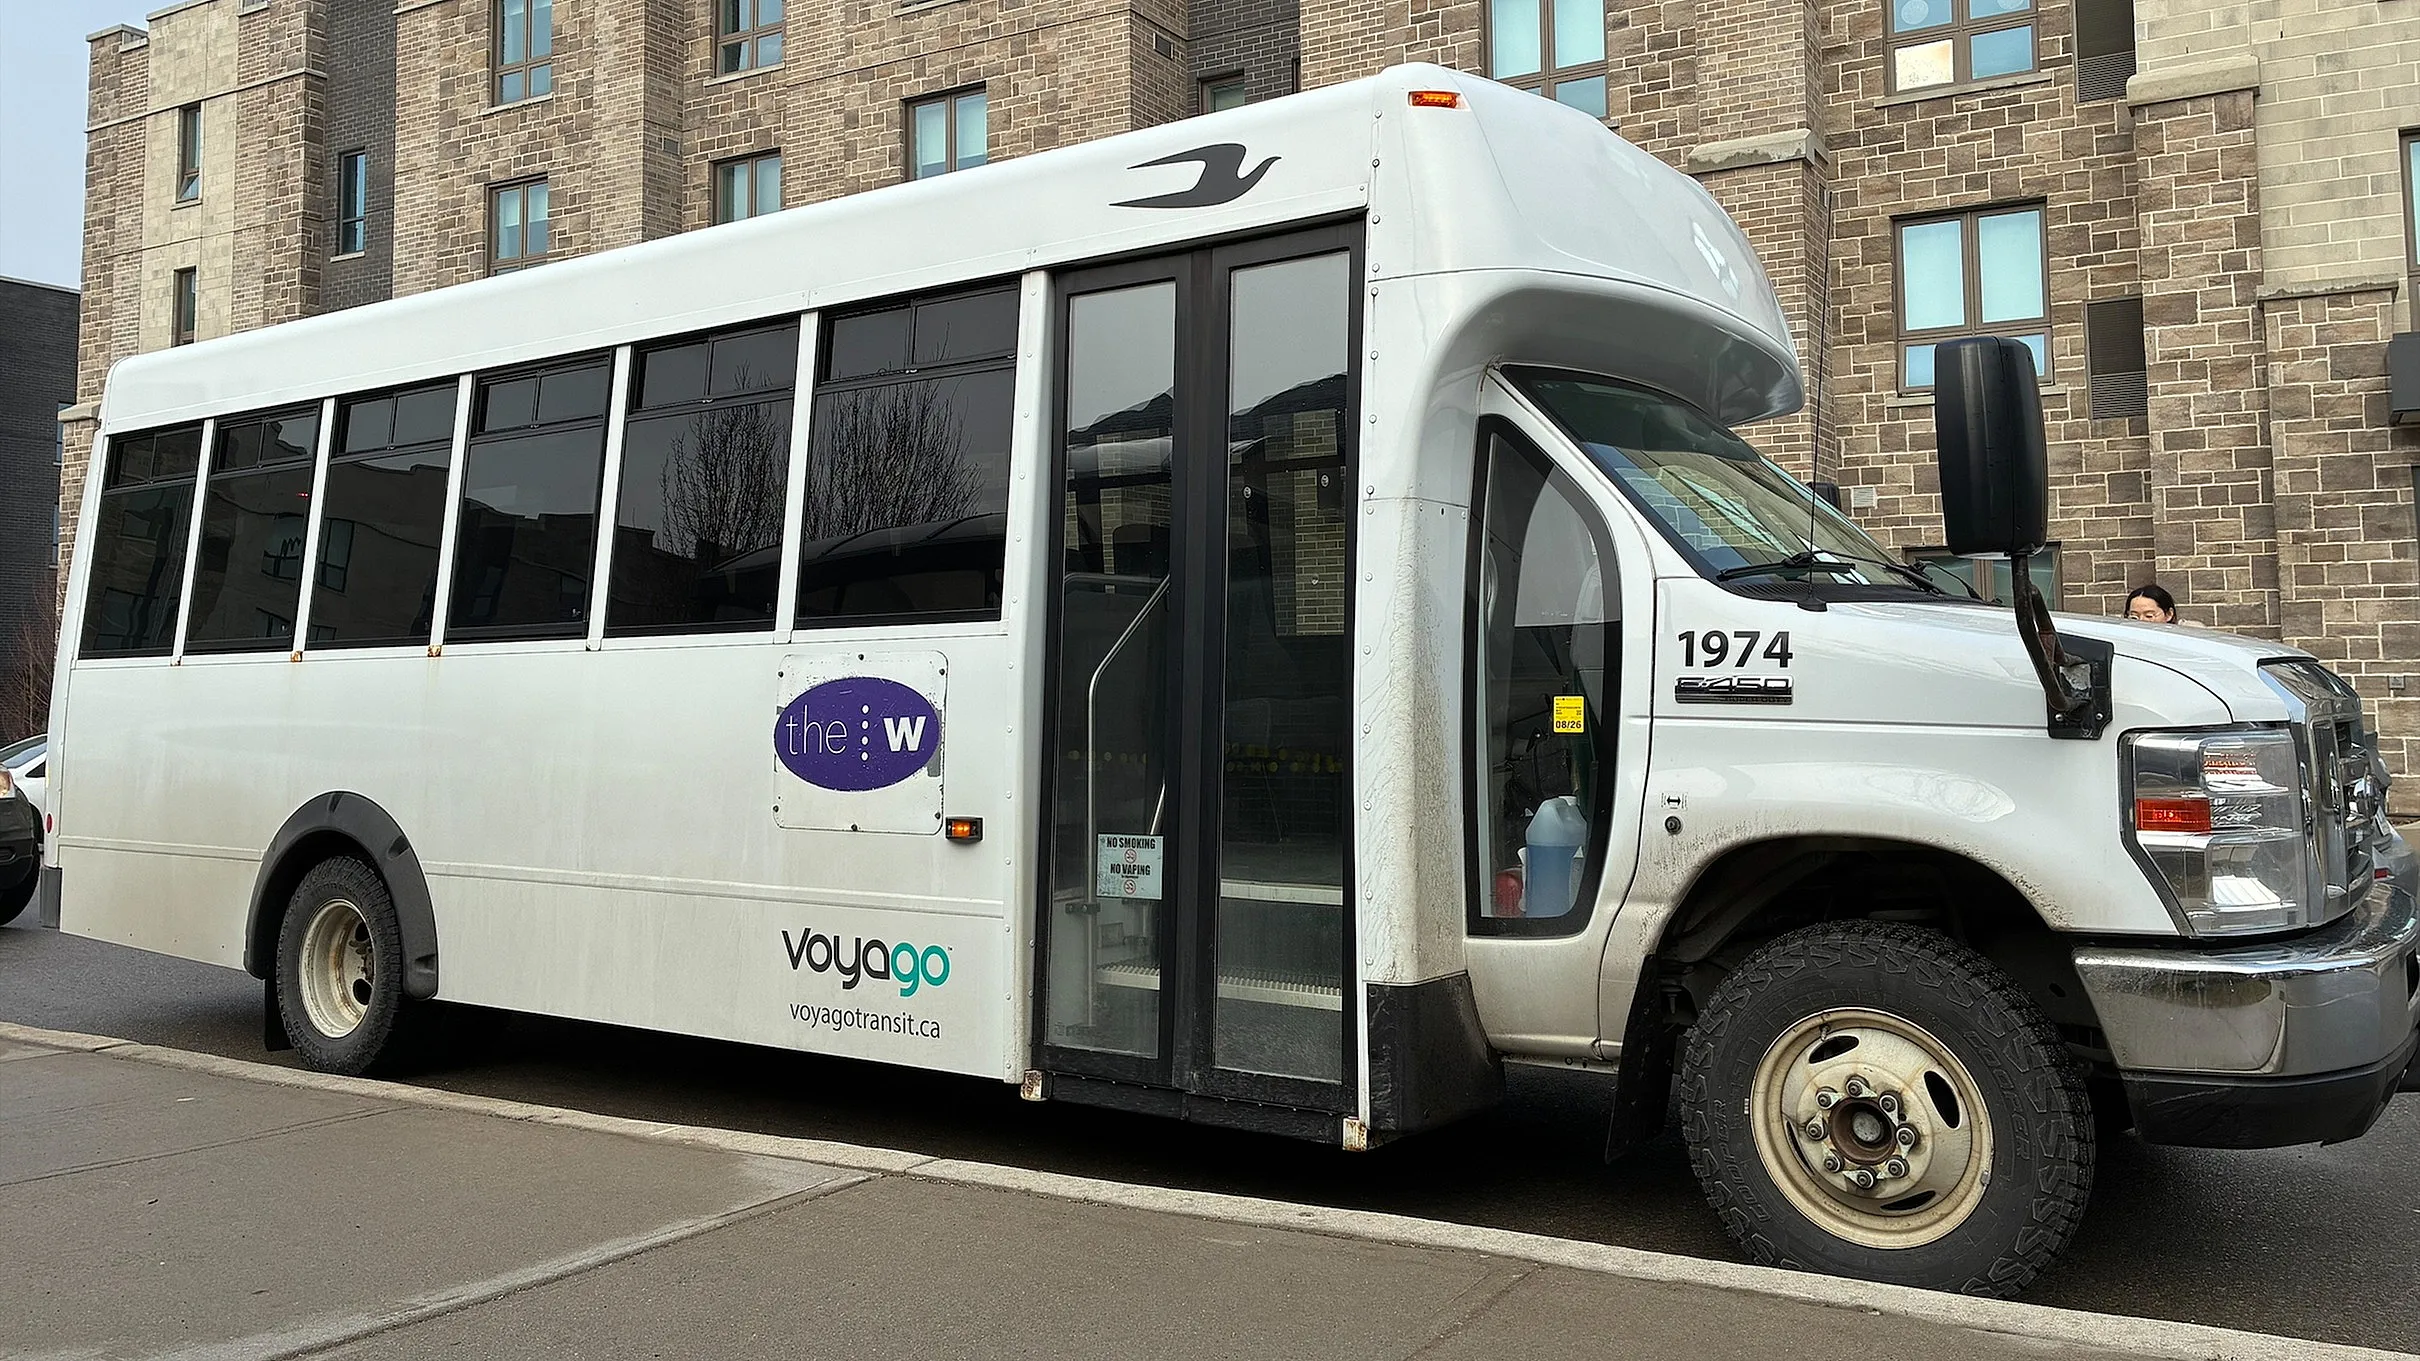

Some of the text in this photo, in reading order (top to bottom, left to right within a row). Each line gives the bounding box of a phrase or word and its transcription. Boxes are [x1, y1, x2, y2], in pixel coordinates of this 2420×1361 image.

[1678, 630, 1793, 668] 1974
[785, 704, 848, 755] the
[1555, 720, 1582, 729] 08/26
[1107, 837, 1156, 849] NO SMOKING
[1110, 863, 1151, 876] NO VAPING
[781, 927, 951, 998] voyago
[789, 1003, 941, 1039] voyagotransit.ca
[1963, 1030, 2031, 1160] COOPER
